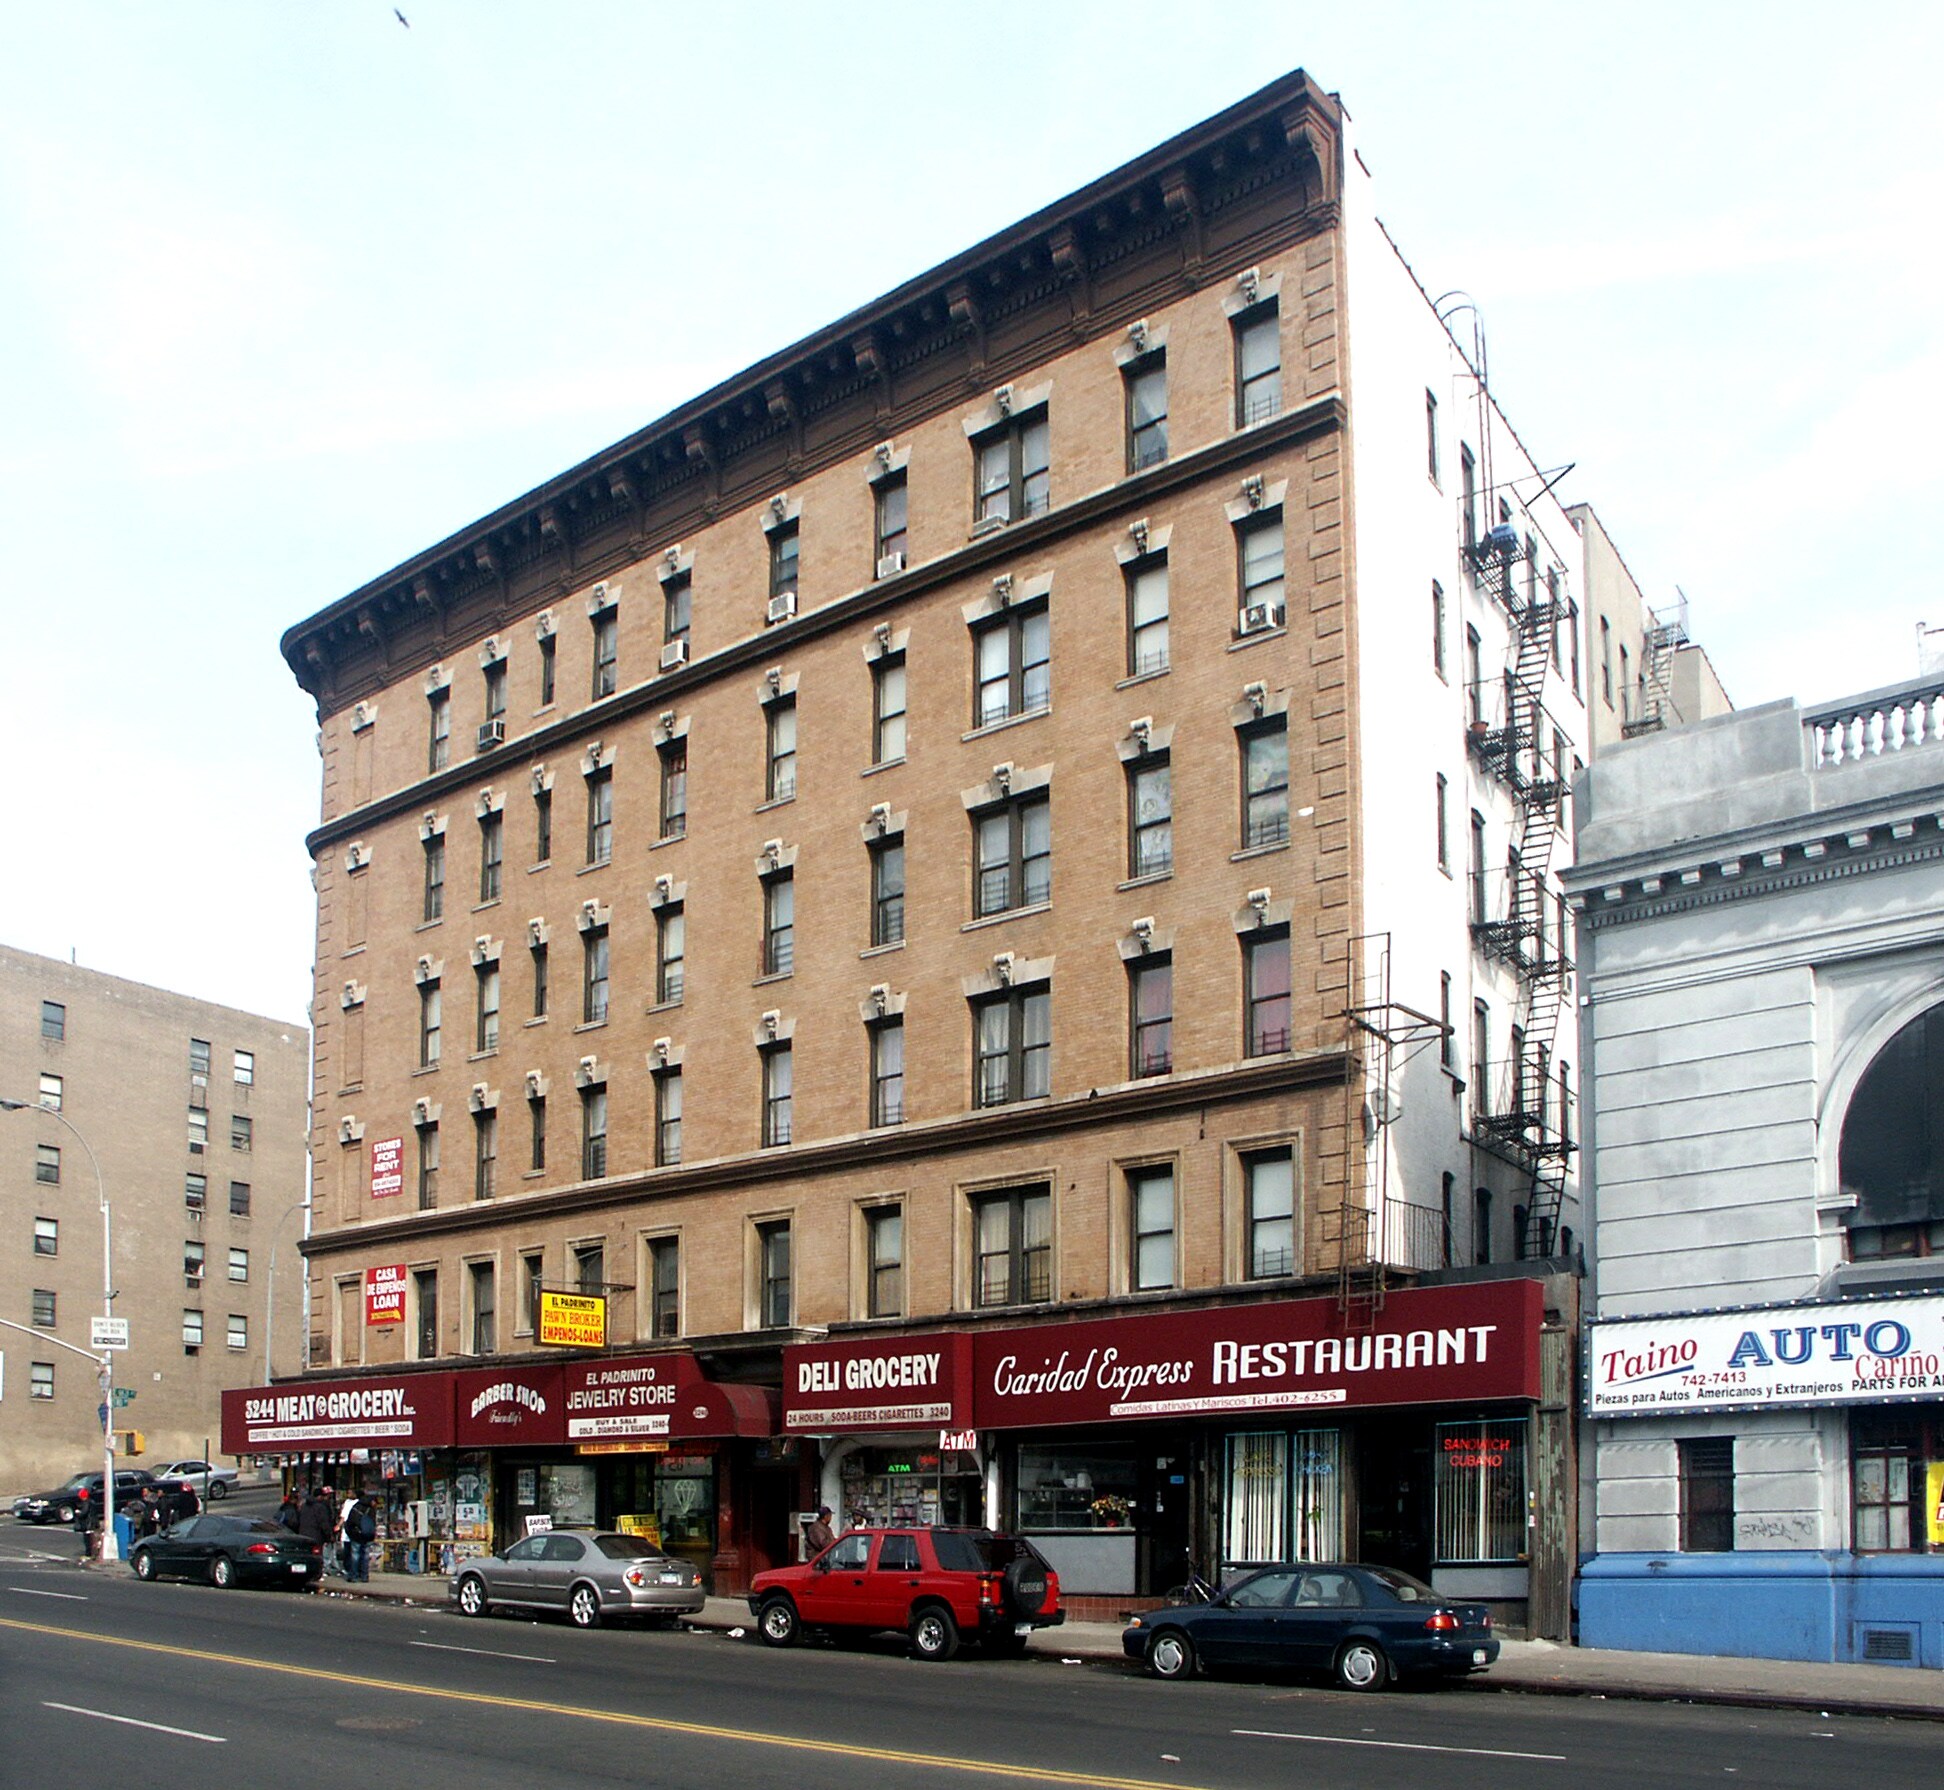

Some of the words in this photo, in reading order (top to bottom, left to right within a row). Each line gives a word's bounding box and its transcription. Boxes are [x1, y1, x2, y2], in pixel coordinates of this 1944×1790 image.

[377, 1151, 396, 1162] FOR
[374, 1160, 399, 1172] RENT
[376, 1268, 396, 1281] CASA
[373, 1294, 399, 1309] LOAN
[552, 1297, 558, 1305] EL
[1727, 1320, 1911, 1369] AUTO
[994, 1348, 1098, 1396] Caridad
[1097, 1347, 1194, 1400] Express
[1213, 1326, 1497, 1385] RESTAURANT
[1601, 1338, 1698, 1384] Taino
[1855, 1350, 1939, 1380] Cariño
[586, 1372, 598, 1386] EL
[601, 1368, 655, 1385] PADRINITO
[798, 1361, 840, 1393] DELI
[845, 1353, 941, 1390] GROCERY
[1681, 1371, 1747, 1387] 742-7413
[1852, 1377, 1895, 1391] PARTS
[1900, 1376, 1927, 1389] FOR
[471, 1383, 514, 1418] BARBER
[516, 1384, 547, 1415] SHOP
[566, 1388, 627, 1410] JEWELRY
[629, 1385, 676, 1406] STORE
[1595, 1393, 1629, 1405] Piezas
[1632, 1392, 1656, 1405] para
[1659, 1389, 1690, 1402] Autos
[1697, 1386, 1763, 1400] Americanos
[1766, 1387, 1773, 1398] y
[1776, 1381, 1843, 1397] Extranjeros
[245, 1398, 275, 1420] 3244
[276, 1395, 316, 1422] MEAT
[328, 1388, 405, 1419] GROCERY
[1111, 1403, 1153, 1415] Comidas
[788, 1414, 797, 1424] 24
[798, 1413, 825, 1423] HOURS
[831, 1410, 877, 1423] SODA-BEERS
[879, 1407, 924, 1421] CIGARETTES
[929, 1407, 949, 1418] 3240
[375, 1424, 390, 1434] BEER
[394, 1423, 410, 1433] SODA
[943, 1430, 975, 1449] ATM
[1444, 1438, 1511, 1451] SANDWICH
[888, 1464, 911, 1473] ATM
[1449, 1455, 1503, 1468] CUBANO
